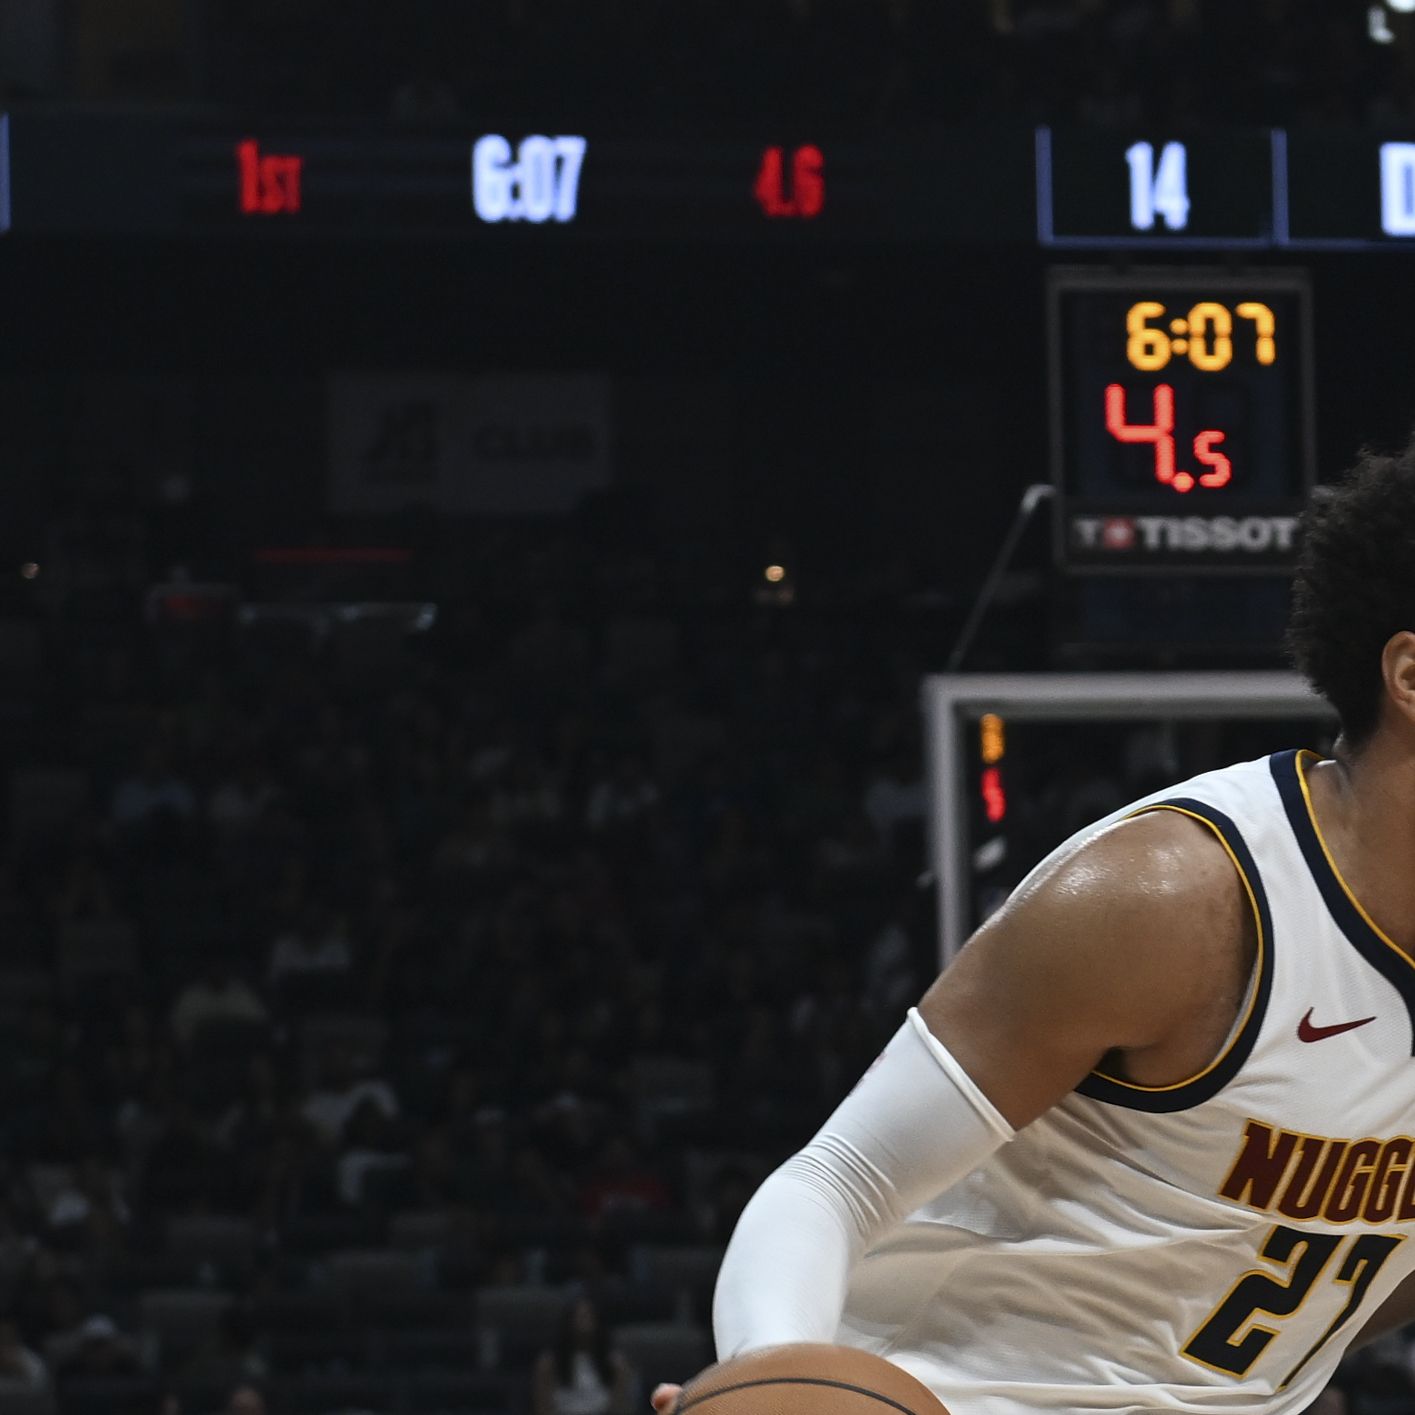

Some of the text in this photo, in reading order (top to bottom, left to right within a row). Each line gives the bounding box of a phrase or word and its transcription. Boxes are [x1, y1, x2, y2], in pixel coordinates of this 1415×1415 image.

[472, 134, 588, 222] 6:07
[1126, 141, 1190, 230] 14
[1126, 301, 1276, 371] 6:07
[1105, 383, 1232, 493] 4.5
[1137, 516, 1299, 550] TISSOT
[1178, 1223, 1409, 1392] 27
